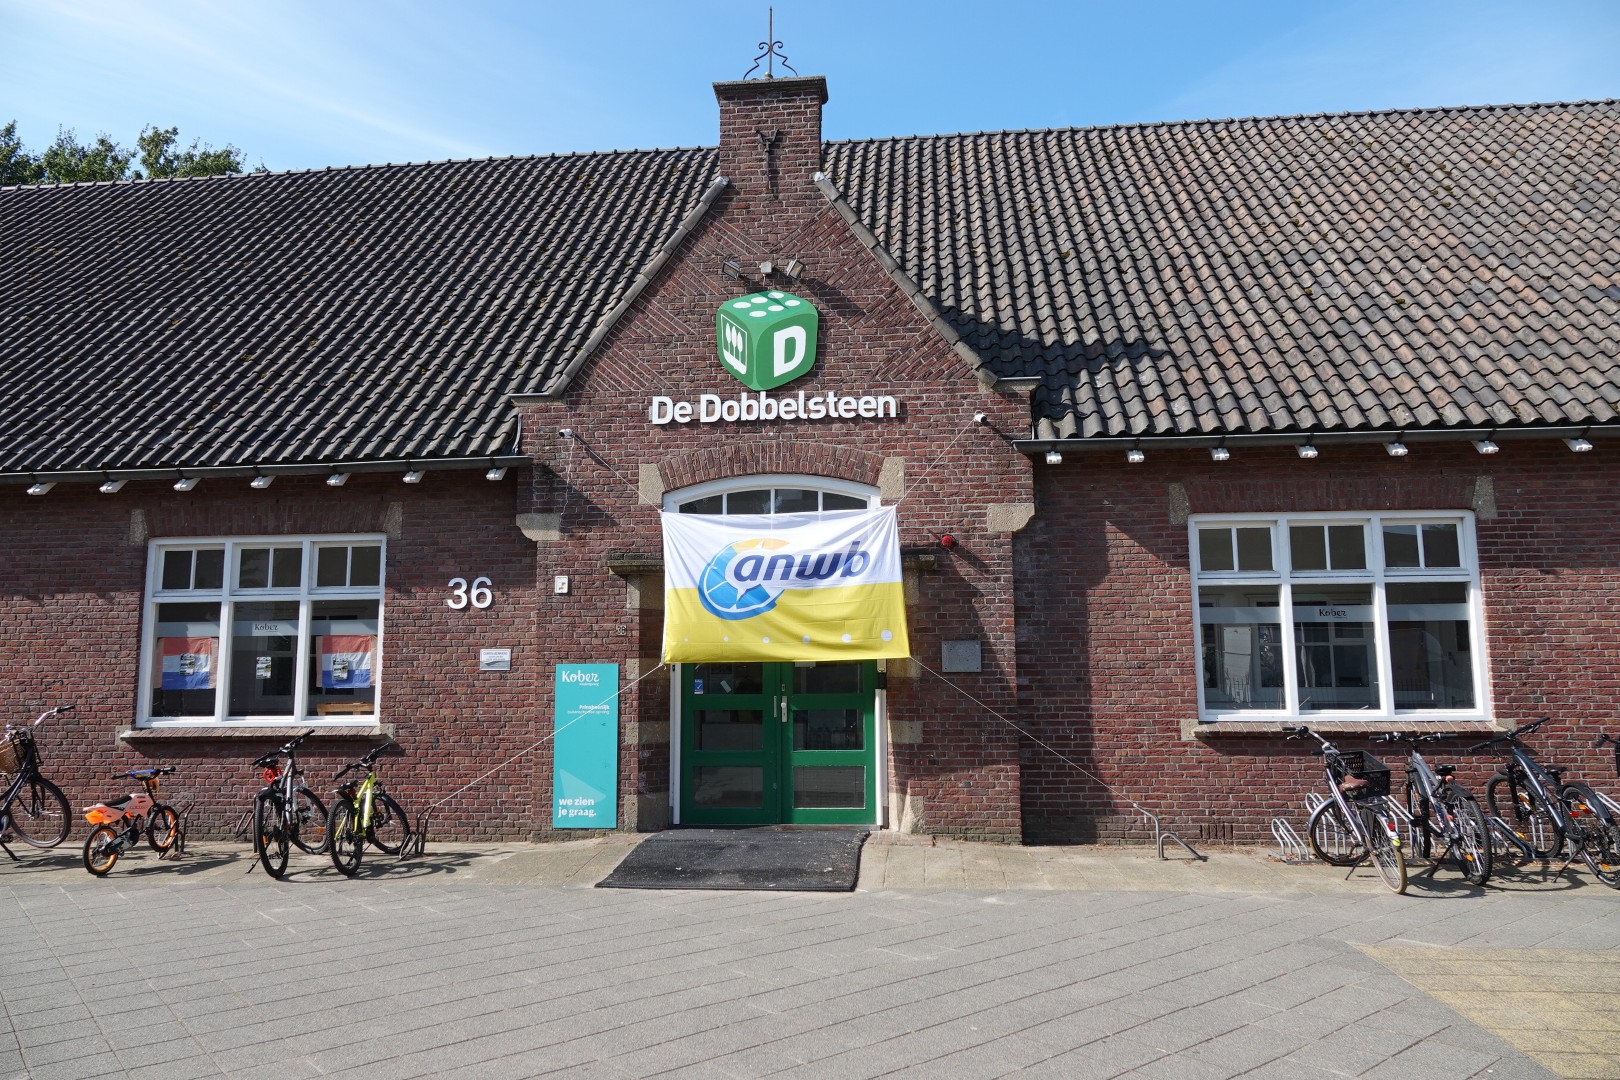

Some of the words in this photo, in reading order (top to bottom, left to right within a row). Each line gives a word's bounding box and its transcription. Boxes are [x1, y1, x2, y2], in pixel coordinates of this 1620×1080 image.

[773, 325, 807, 378] D
[652, 396, 693, 425] De
[699, 390, 897, 423] Dobbelsteen
[733, 540, 871, 582] anwb
[447, 576, 493, 610] 36
[1319, 608, 1347, 616] Kober
[561, 669, 600, 682] Kober
[557, 806, 568, 818] je
[568, 808, 597, 818] graag.
[558, 798, 573, 806] we
[574, 796, 595, 806] zien
